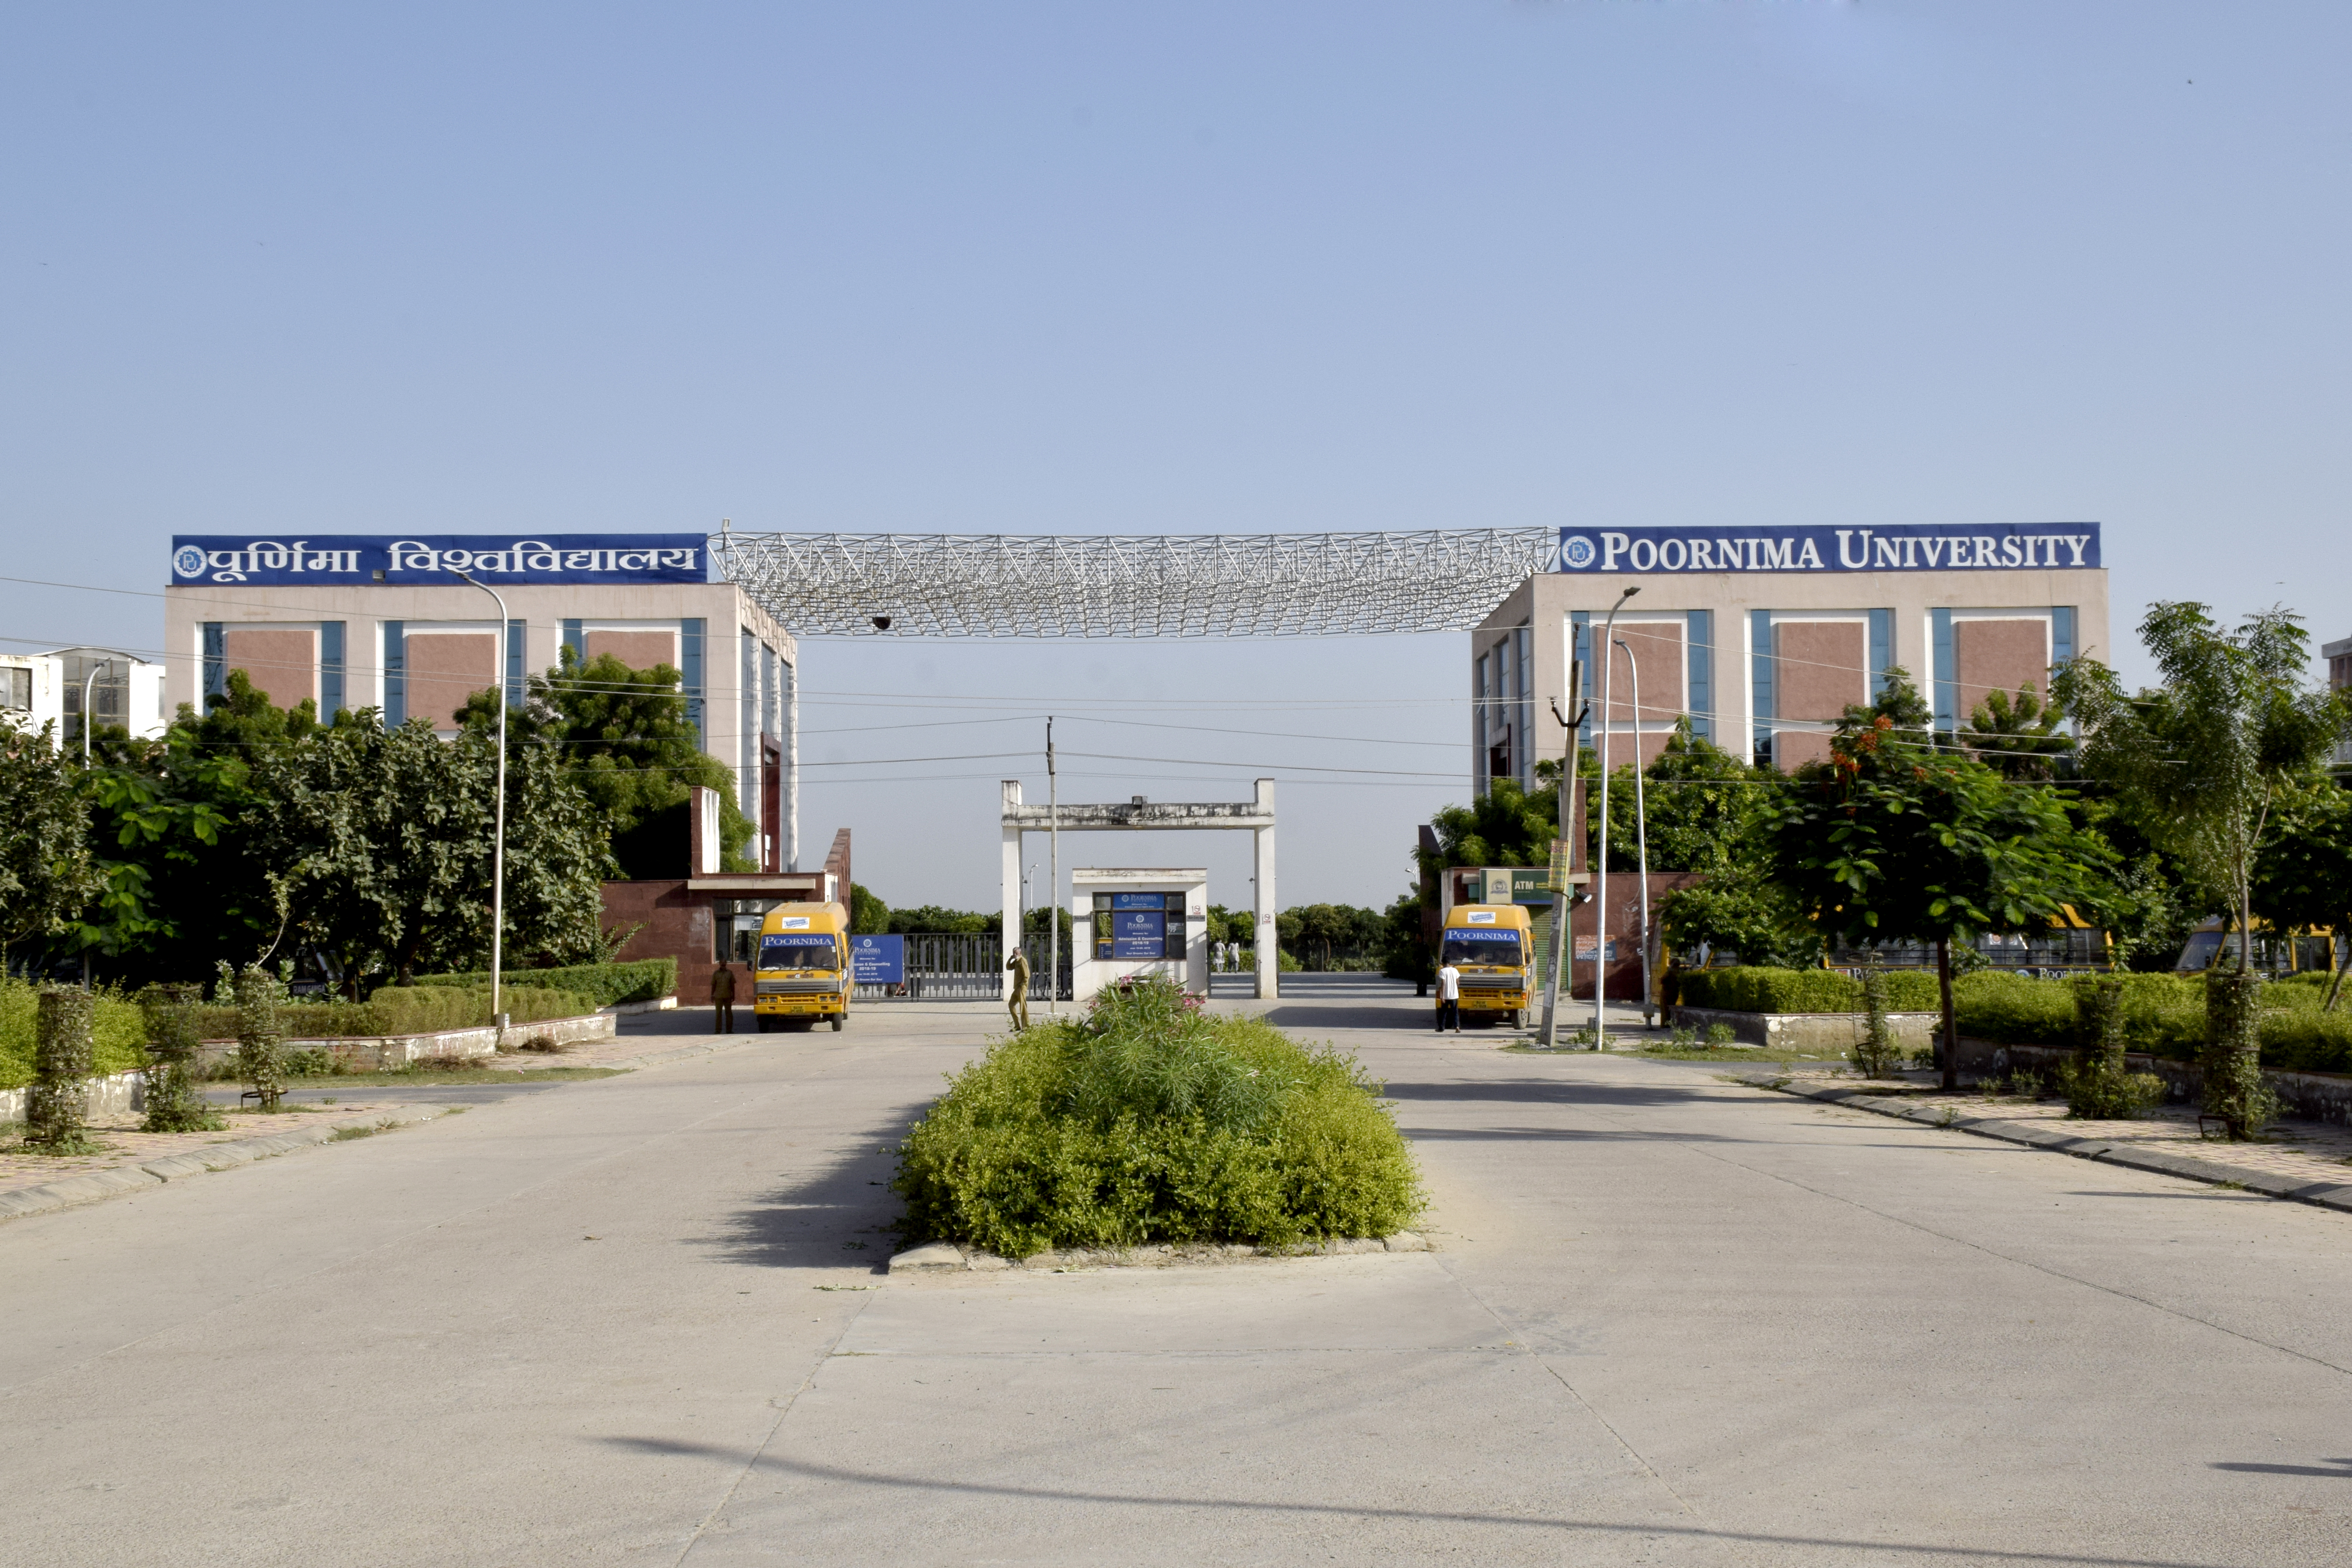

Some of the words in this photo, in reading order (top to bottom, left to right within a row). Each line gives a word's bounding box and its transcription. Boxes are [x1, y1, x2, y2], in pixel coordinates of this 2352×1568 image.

[1601, 532, 1825, 570] POORNIMA
[1835, 530, 2090, 568] UNIVERSITY
[207, 541, 361, 582] पूर्णिमा
[387, 541, 699, 574] विश्वविद्यालय
[1514, 881, 1534, 890] ATM
[1448, 930, 1516, 940] POORNIMA
[764, 936, 832, 946] POORNIMA
